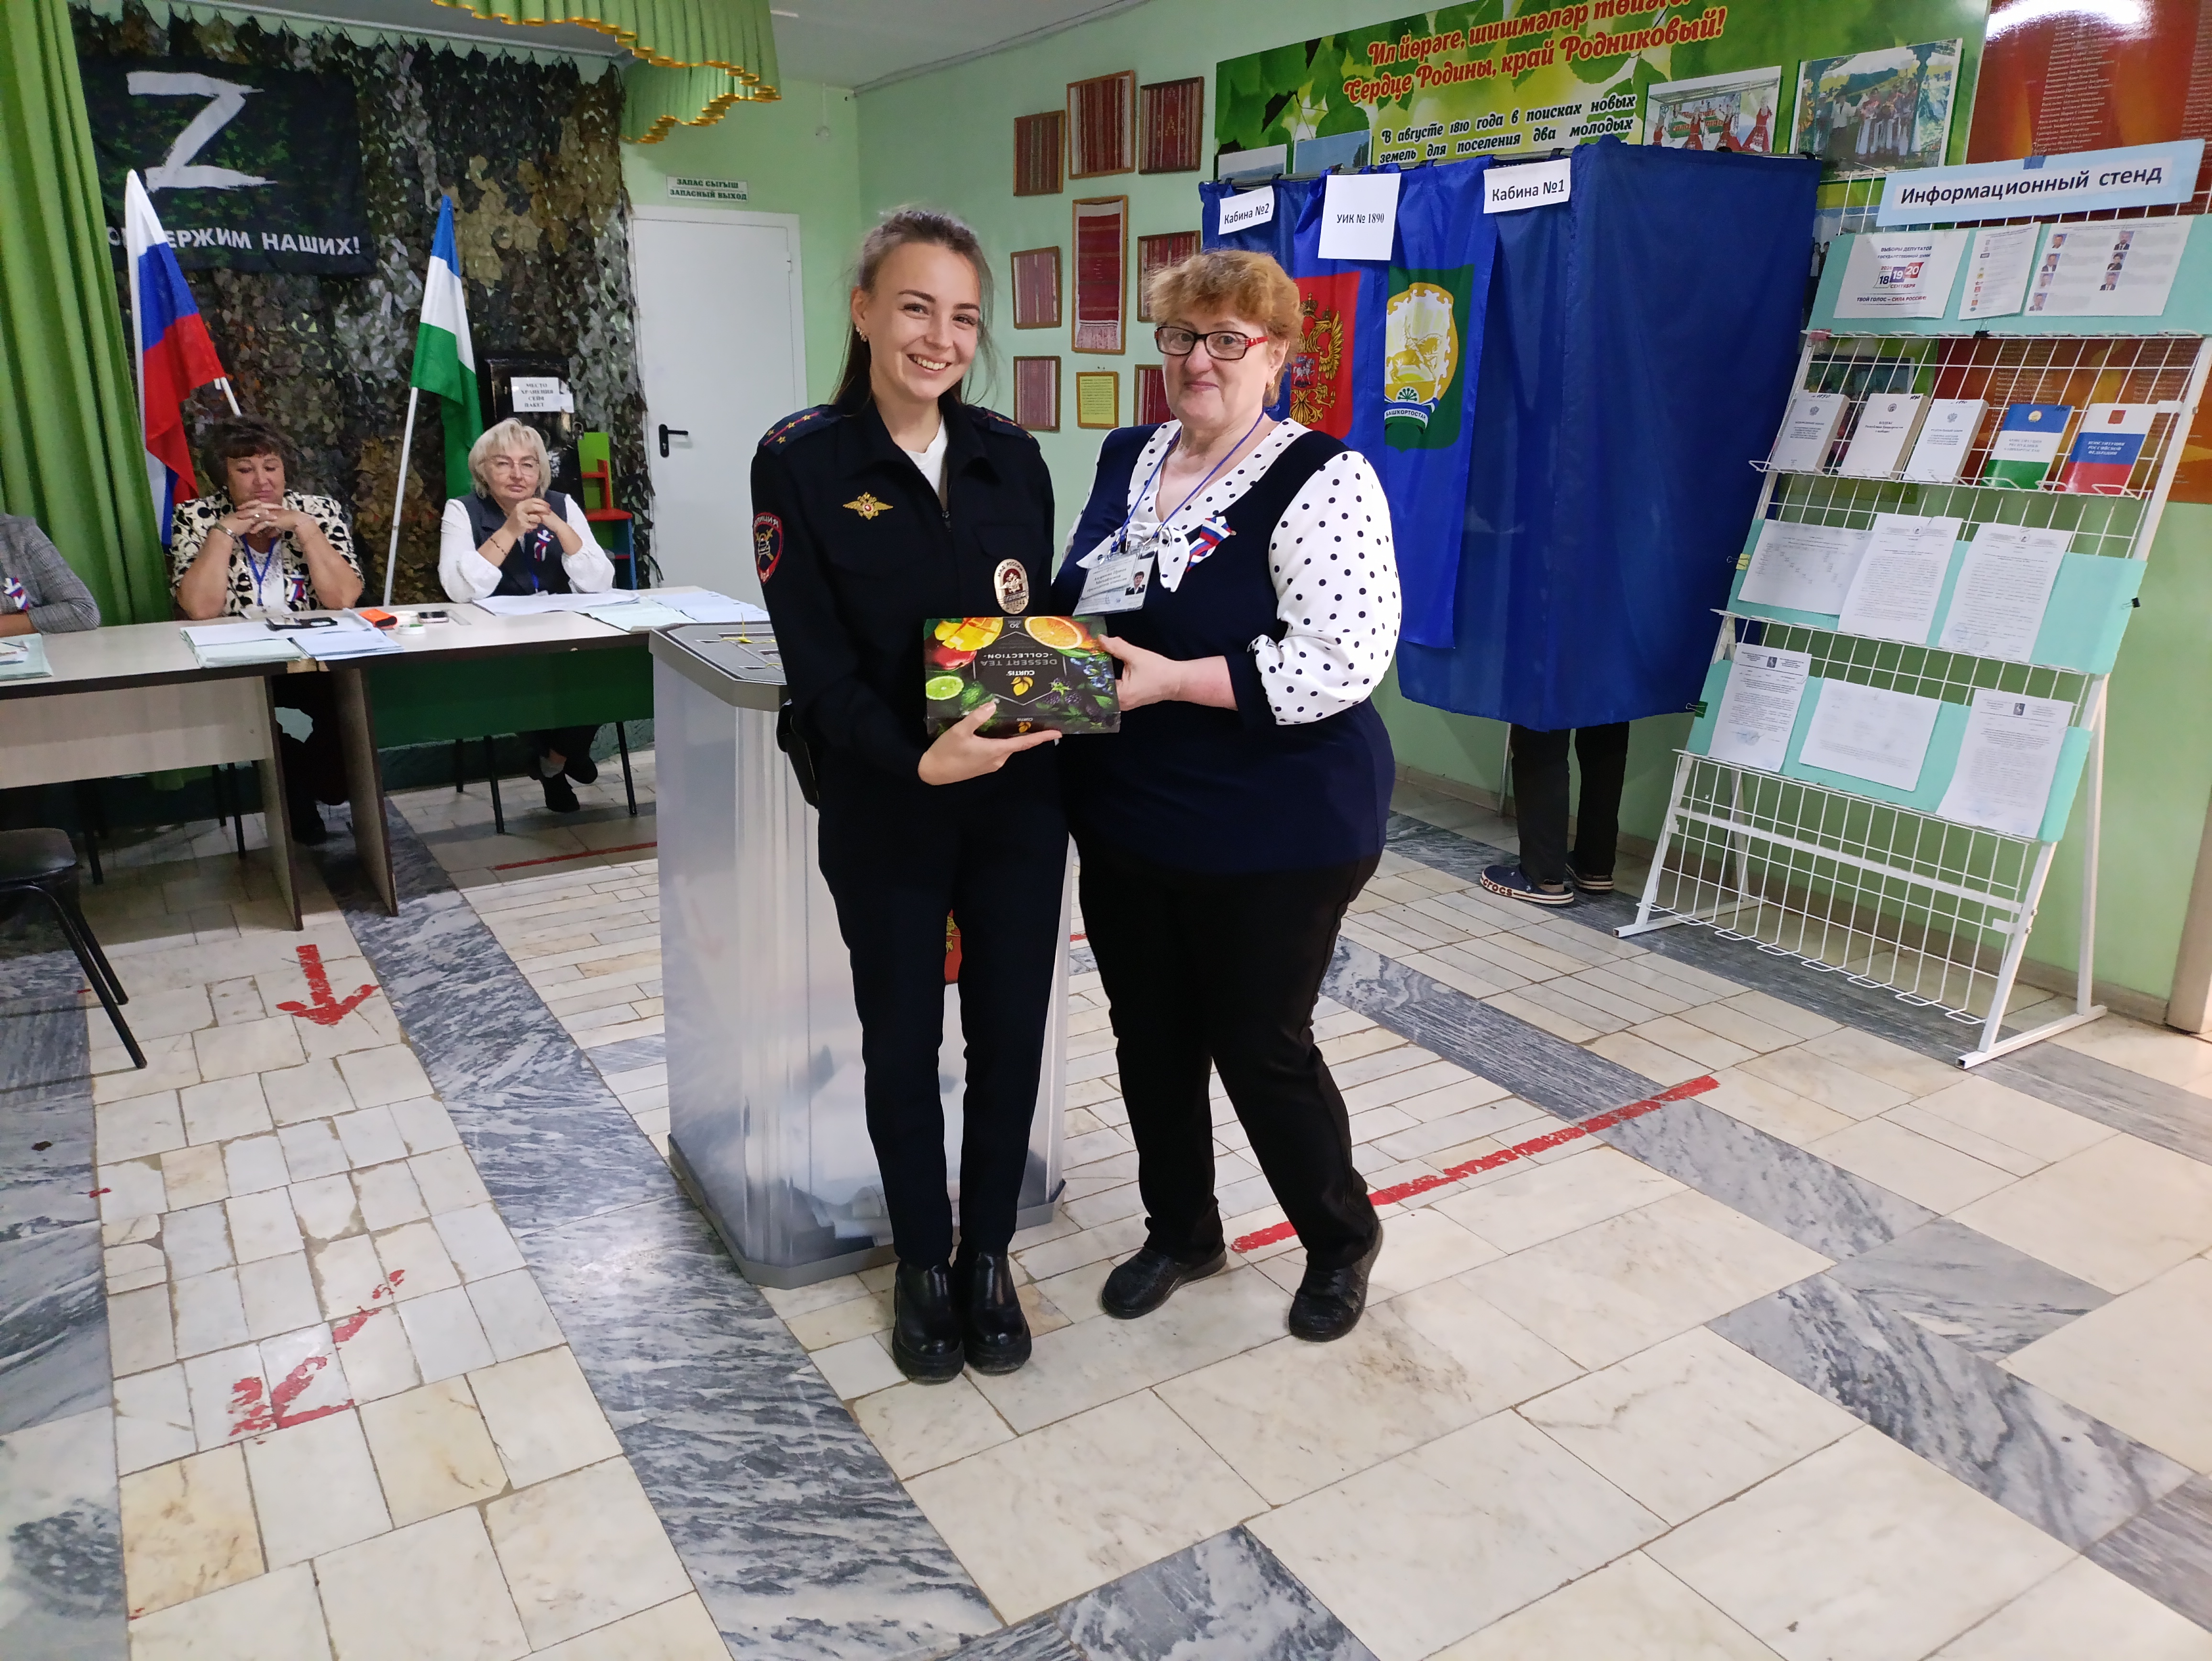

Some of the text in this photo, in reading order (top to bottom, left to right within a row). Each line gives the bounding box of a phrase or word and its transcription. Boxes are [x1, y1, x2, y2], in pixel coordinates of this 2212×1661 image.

[1344, 7, 1727, 103] Сердце Родины, край Родниковый!
[127, 70, 278, 192] Z
[1381, 94, 1637, 144] В августе 1810 года в поисках новых
[1380, 117, 1634, 164] земель для поселения два молодых
[670, 189, 747, 200] ЗАПАСНЫЙ ВЫХОД
[1492, 178, 1565, 202] Кабина №1
[1901, 166, 2163, 206] Информационный стенд
[1224, 202, 1269, 225] Кабина №2
[1337, 212, 1384, 224] УИК № 1890
[108, 226, 361, 255] ОЕРЖИМ НАШИХ!
[1880, 266, 1919, 284] 18 19 20
